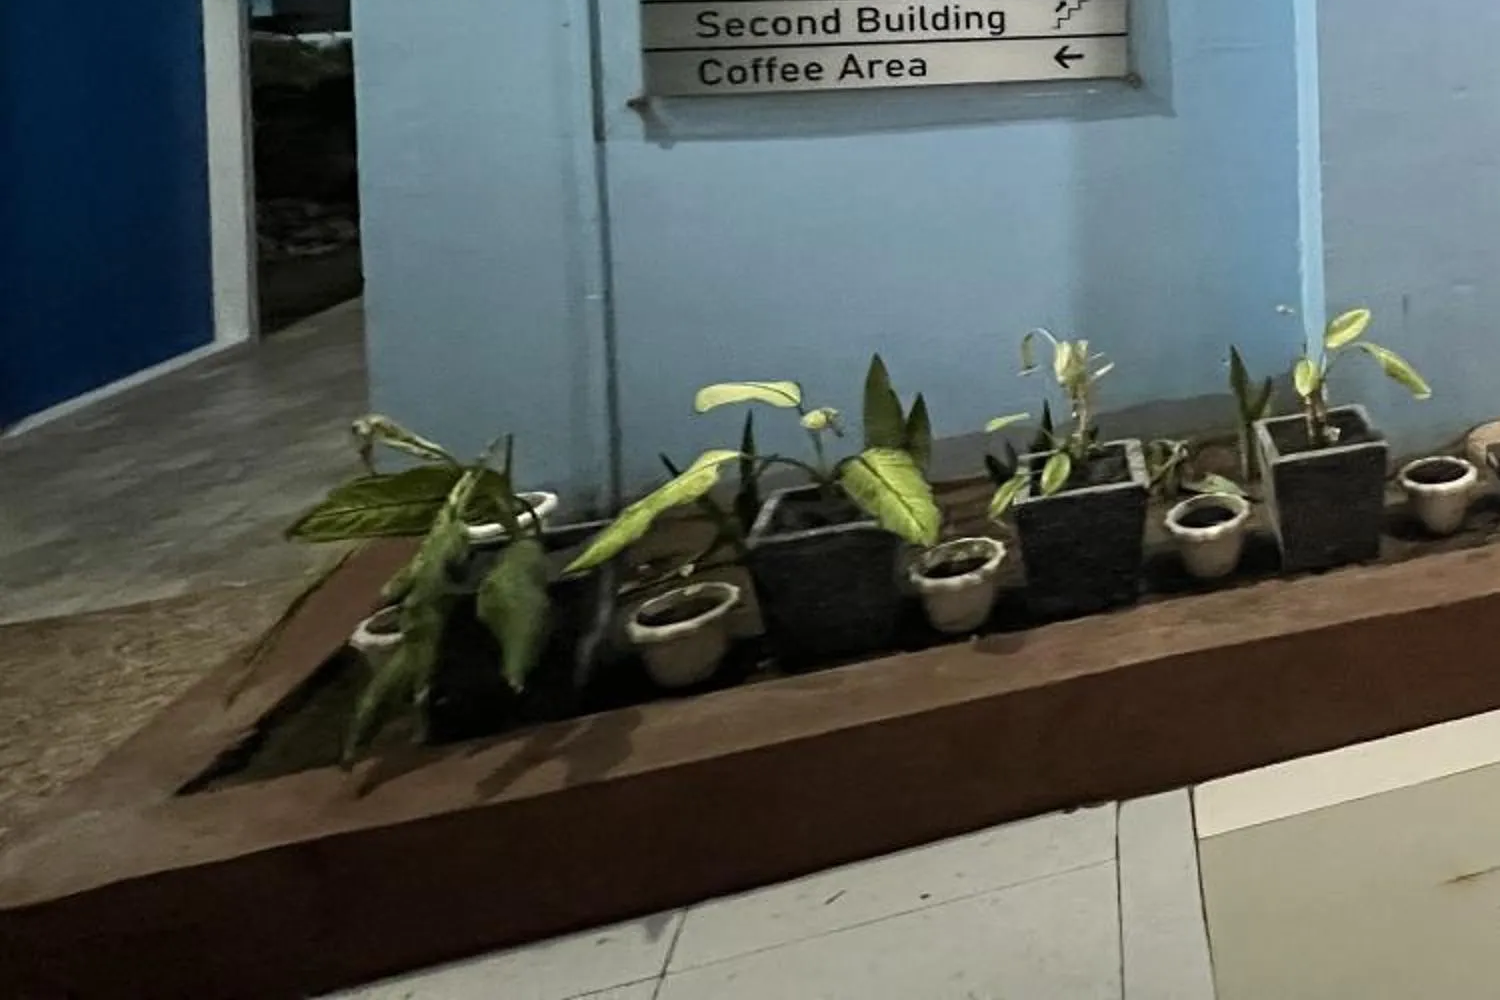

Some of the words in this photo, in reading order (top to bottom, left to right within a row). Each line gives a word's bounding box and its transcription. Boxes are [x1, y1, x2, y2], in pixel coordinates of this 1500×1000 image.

[696, 8, 841, 38] Second
[857, 5, 1007, 36] Building
[700, 56, 824, 86] Coffee
[838, 53, 928, 81] Area
